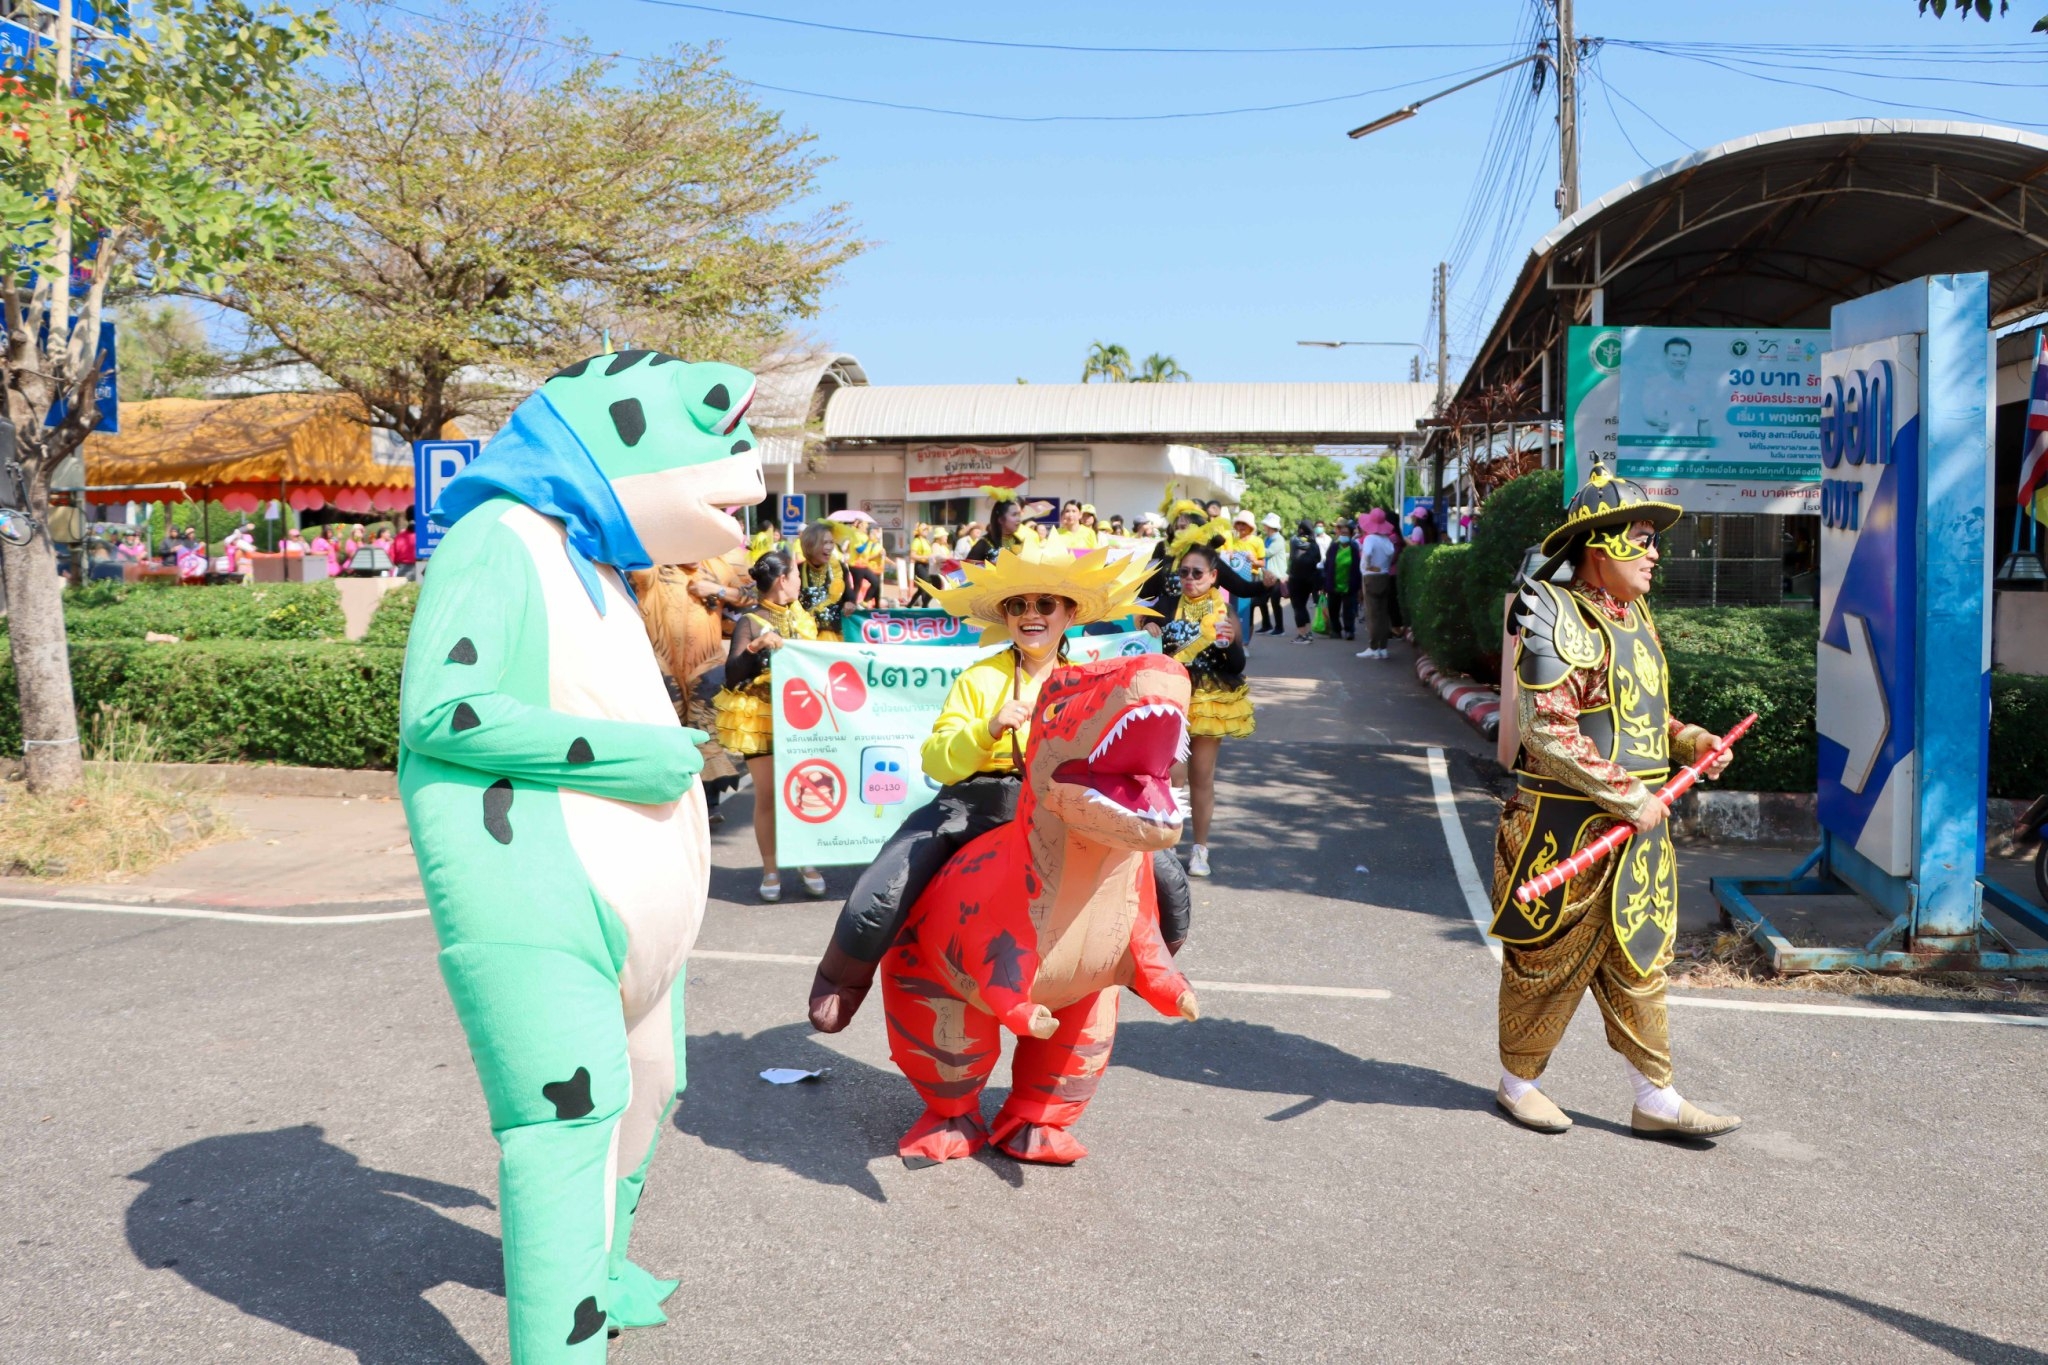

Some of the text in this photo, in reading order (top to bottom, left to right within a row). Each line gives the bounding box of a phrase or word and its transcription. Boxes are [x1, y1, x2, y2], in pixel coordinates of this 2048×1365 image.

[1729, 369, 1755, 386] 30
[1760, 372, 1800, 386] บาท
[1759, 412, 1764, 421] 1
[1741, 488, 1757, 498] คน
[1821, 478, 1863, 531] OUT
[868, 783, 901, 792] 80-130
